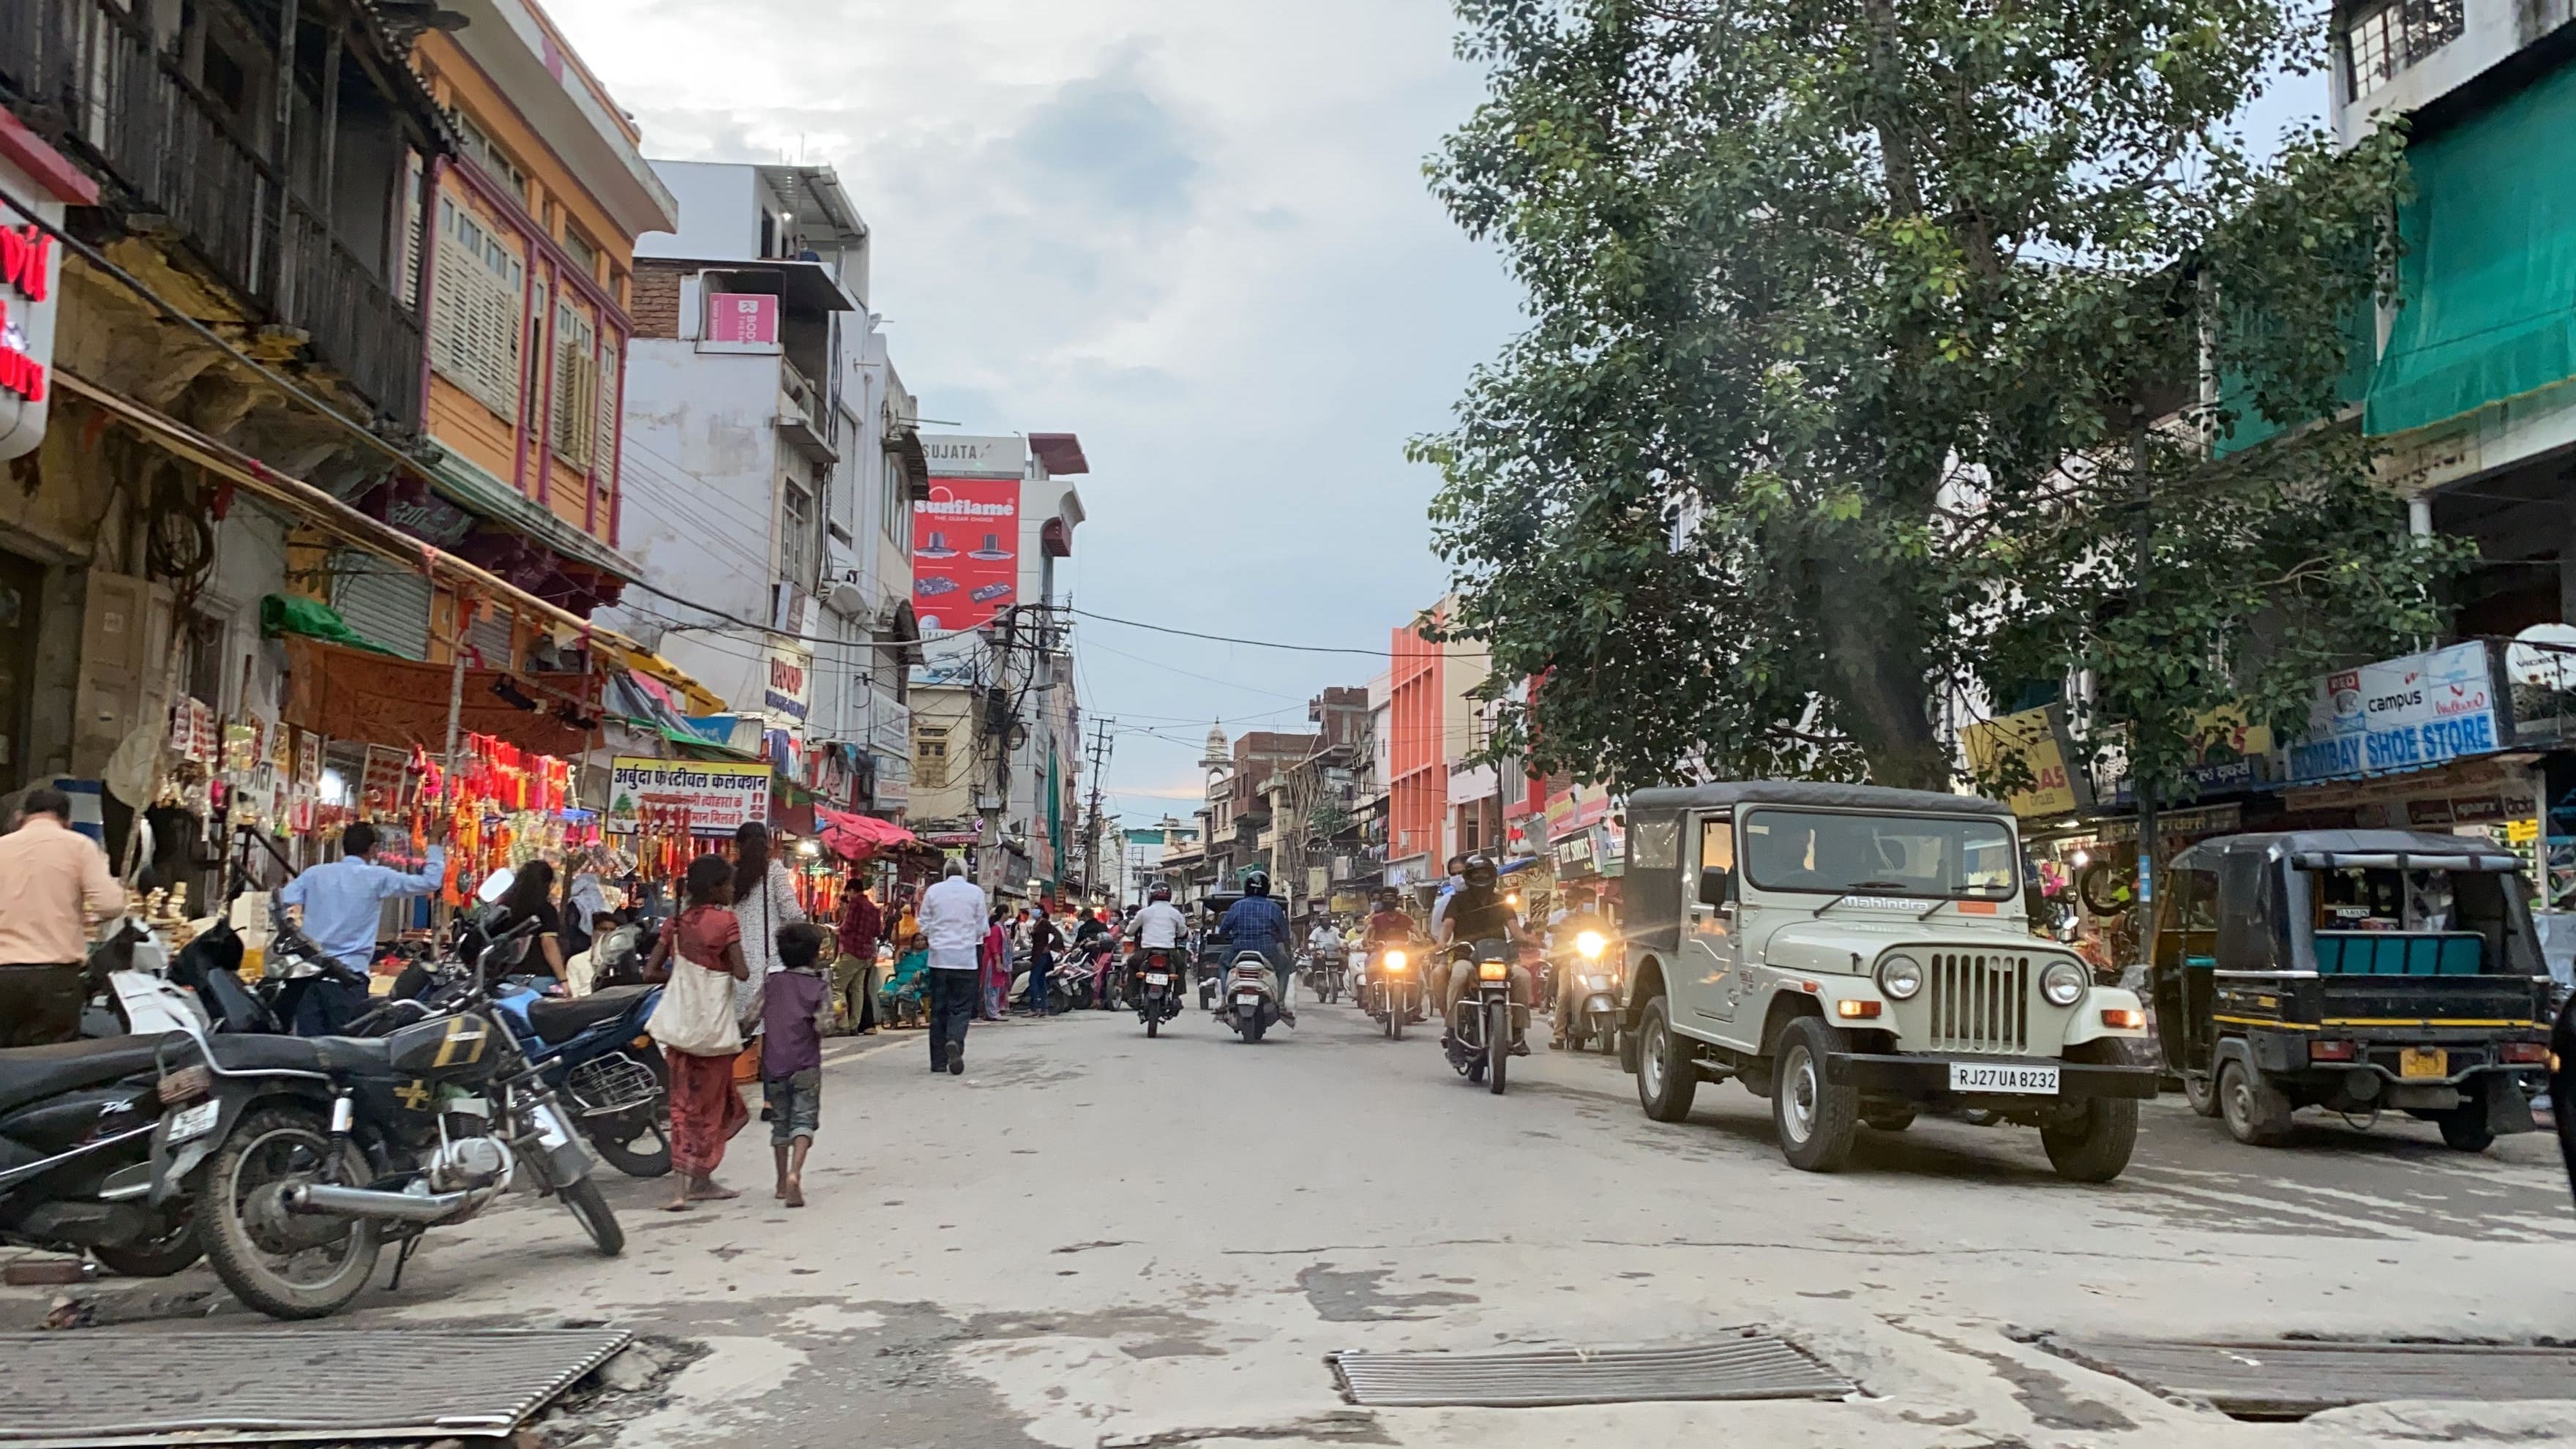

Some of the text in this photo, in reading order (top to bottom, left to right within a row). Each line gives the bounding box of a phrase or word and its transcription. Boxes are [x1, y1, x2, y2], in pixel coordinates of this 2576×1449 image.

[923, 443, 977, 460] SUJATA
[915, 499, 1014, 516] sunflame
[2368, 690, 2422, 712] campus
[2365, 727, 2419, 768] SHOE
[2423, 714, 2492, 759] STORE
[615, 763, 768, 790] अर्बुदा फेस्टीवल कलेक्शन
[1570, 837, 1590, 861] SHOES
[1841, 896, 1928, 911] Mahindra
